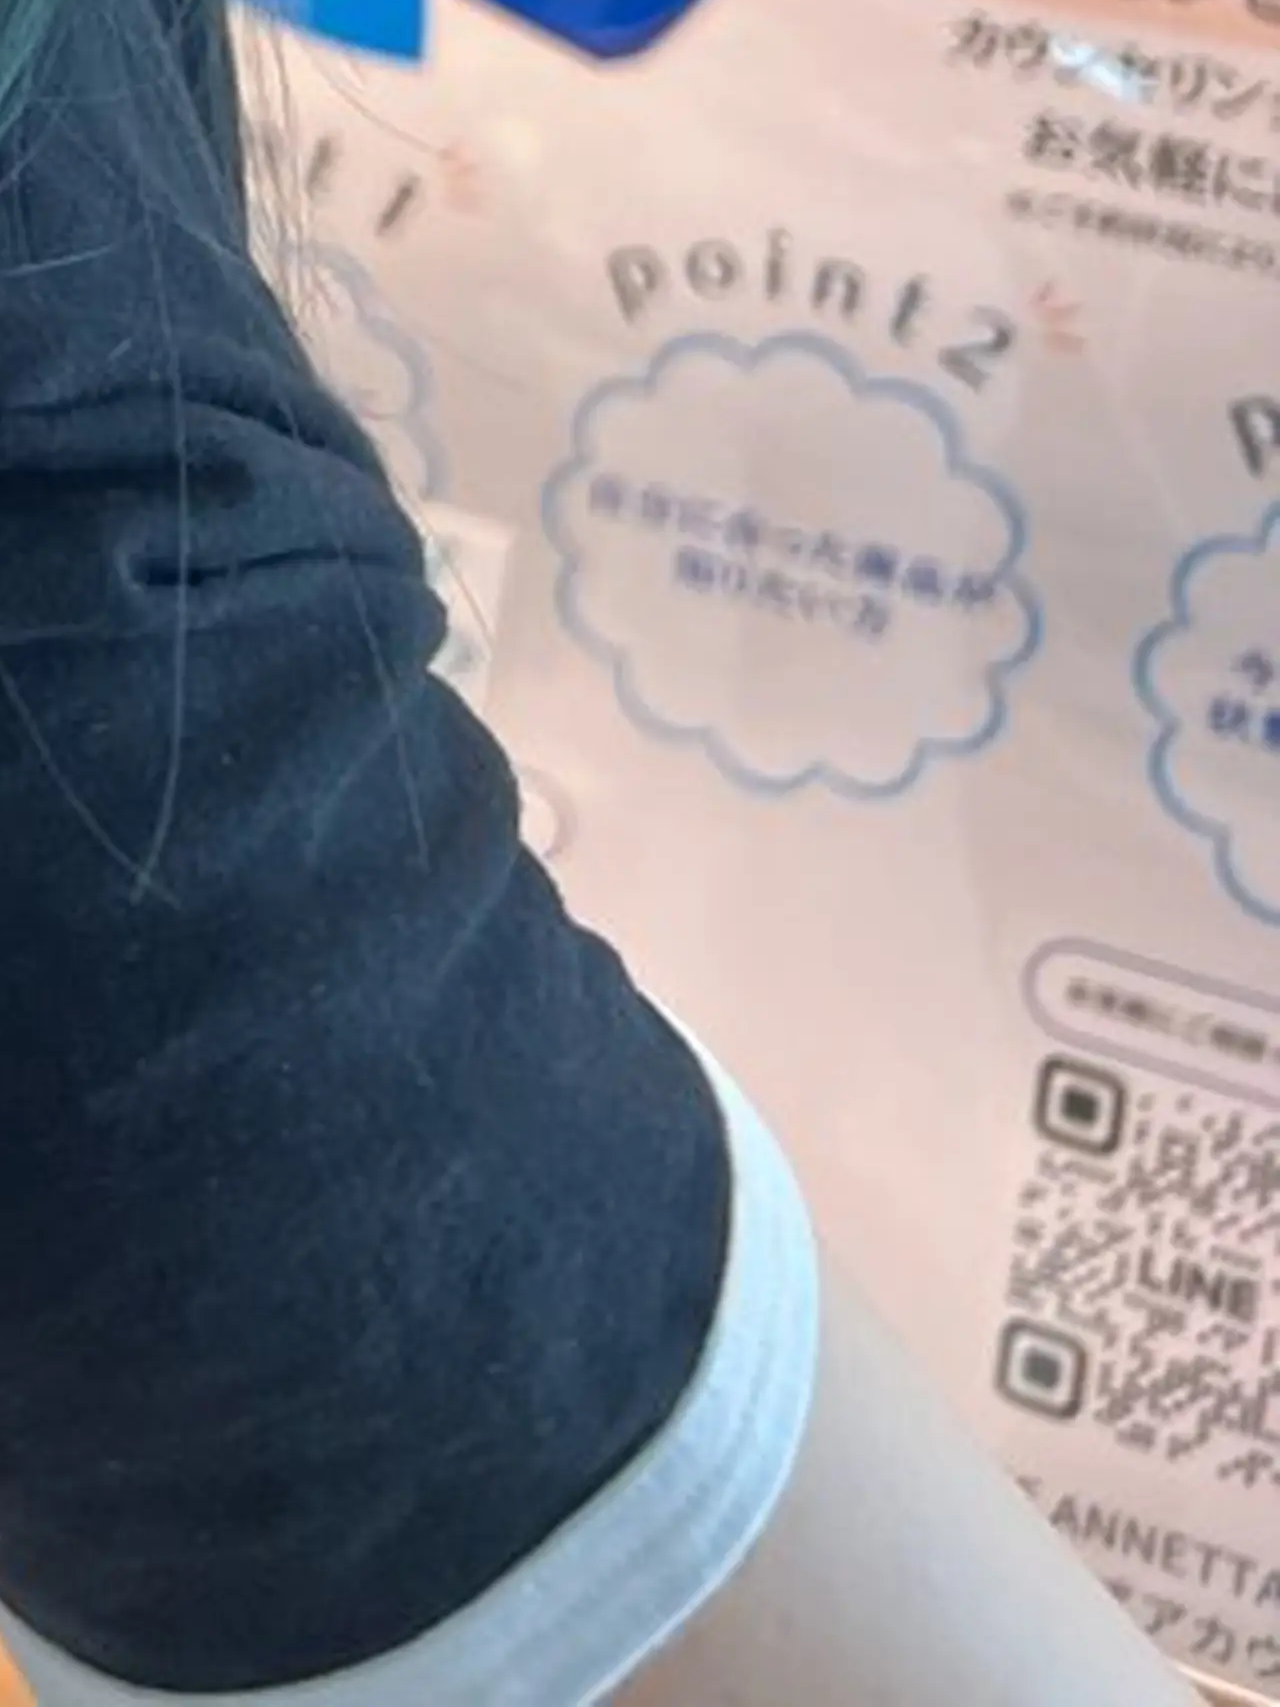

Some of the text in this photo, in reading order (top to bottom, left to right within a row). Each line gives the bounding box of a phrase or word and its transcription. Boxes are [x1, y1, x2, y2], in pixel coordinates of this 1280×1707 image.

[1024, 107, 1280, 215] お気軽に
[608, 227, 1016, 391] point2
[1140, 1247, 1260, 1325] LINE
[1014, 1473, 1280, 1609] ANNETTA
